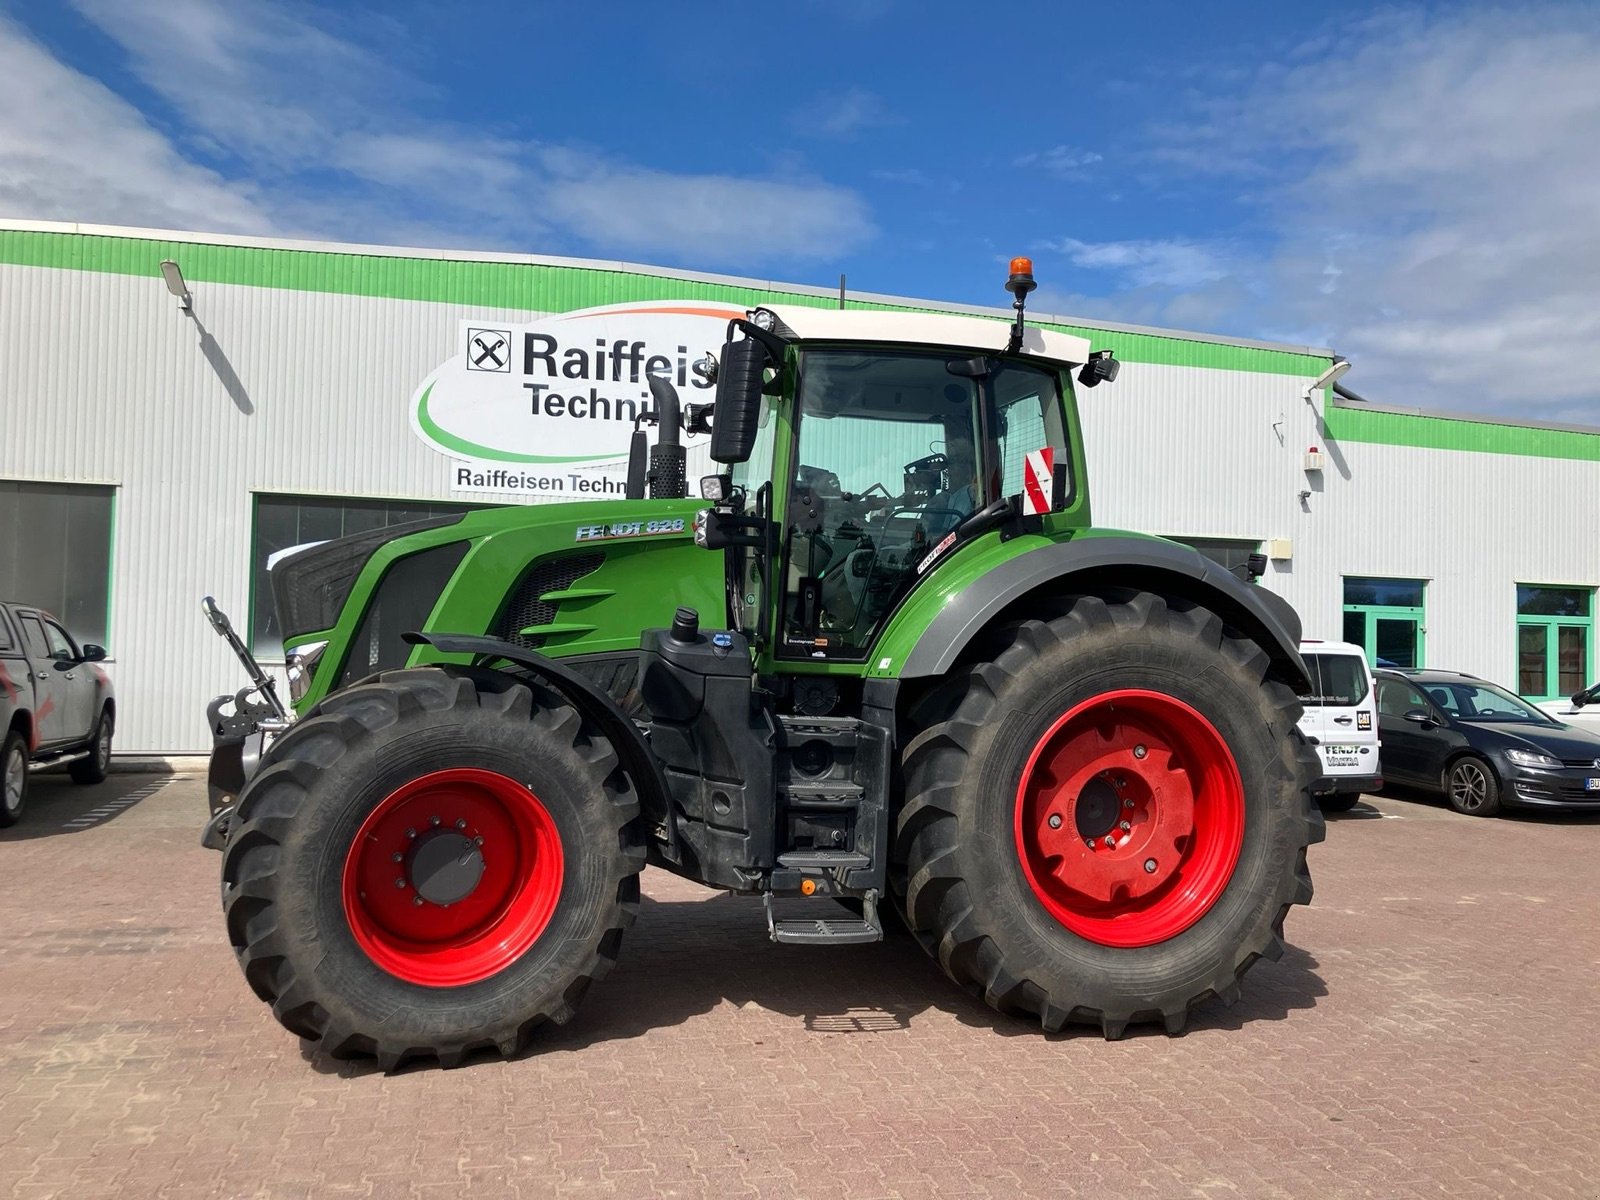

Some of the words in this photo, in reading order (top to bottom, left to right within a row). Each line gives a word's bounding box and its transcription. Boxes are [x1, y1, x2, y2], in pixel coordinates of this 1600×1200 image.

[457, 468, 563, 491] Raiffeisen
[577, 522, 644, 539] FENDT
[646, 519, 685, 533] 828
[1358, 713, 1370, 725] CAT
[1325, 746, 1360, 755] FENDT
